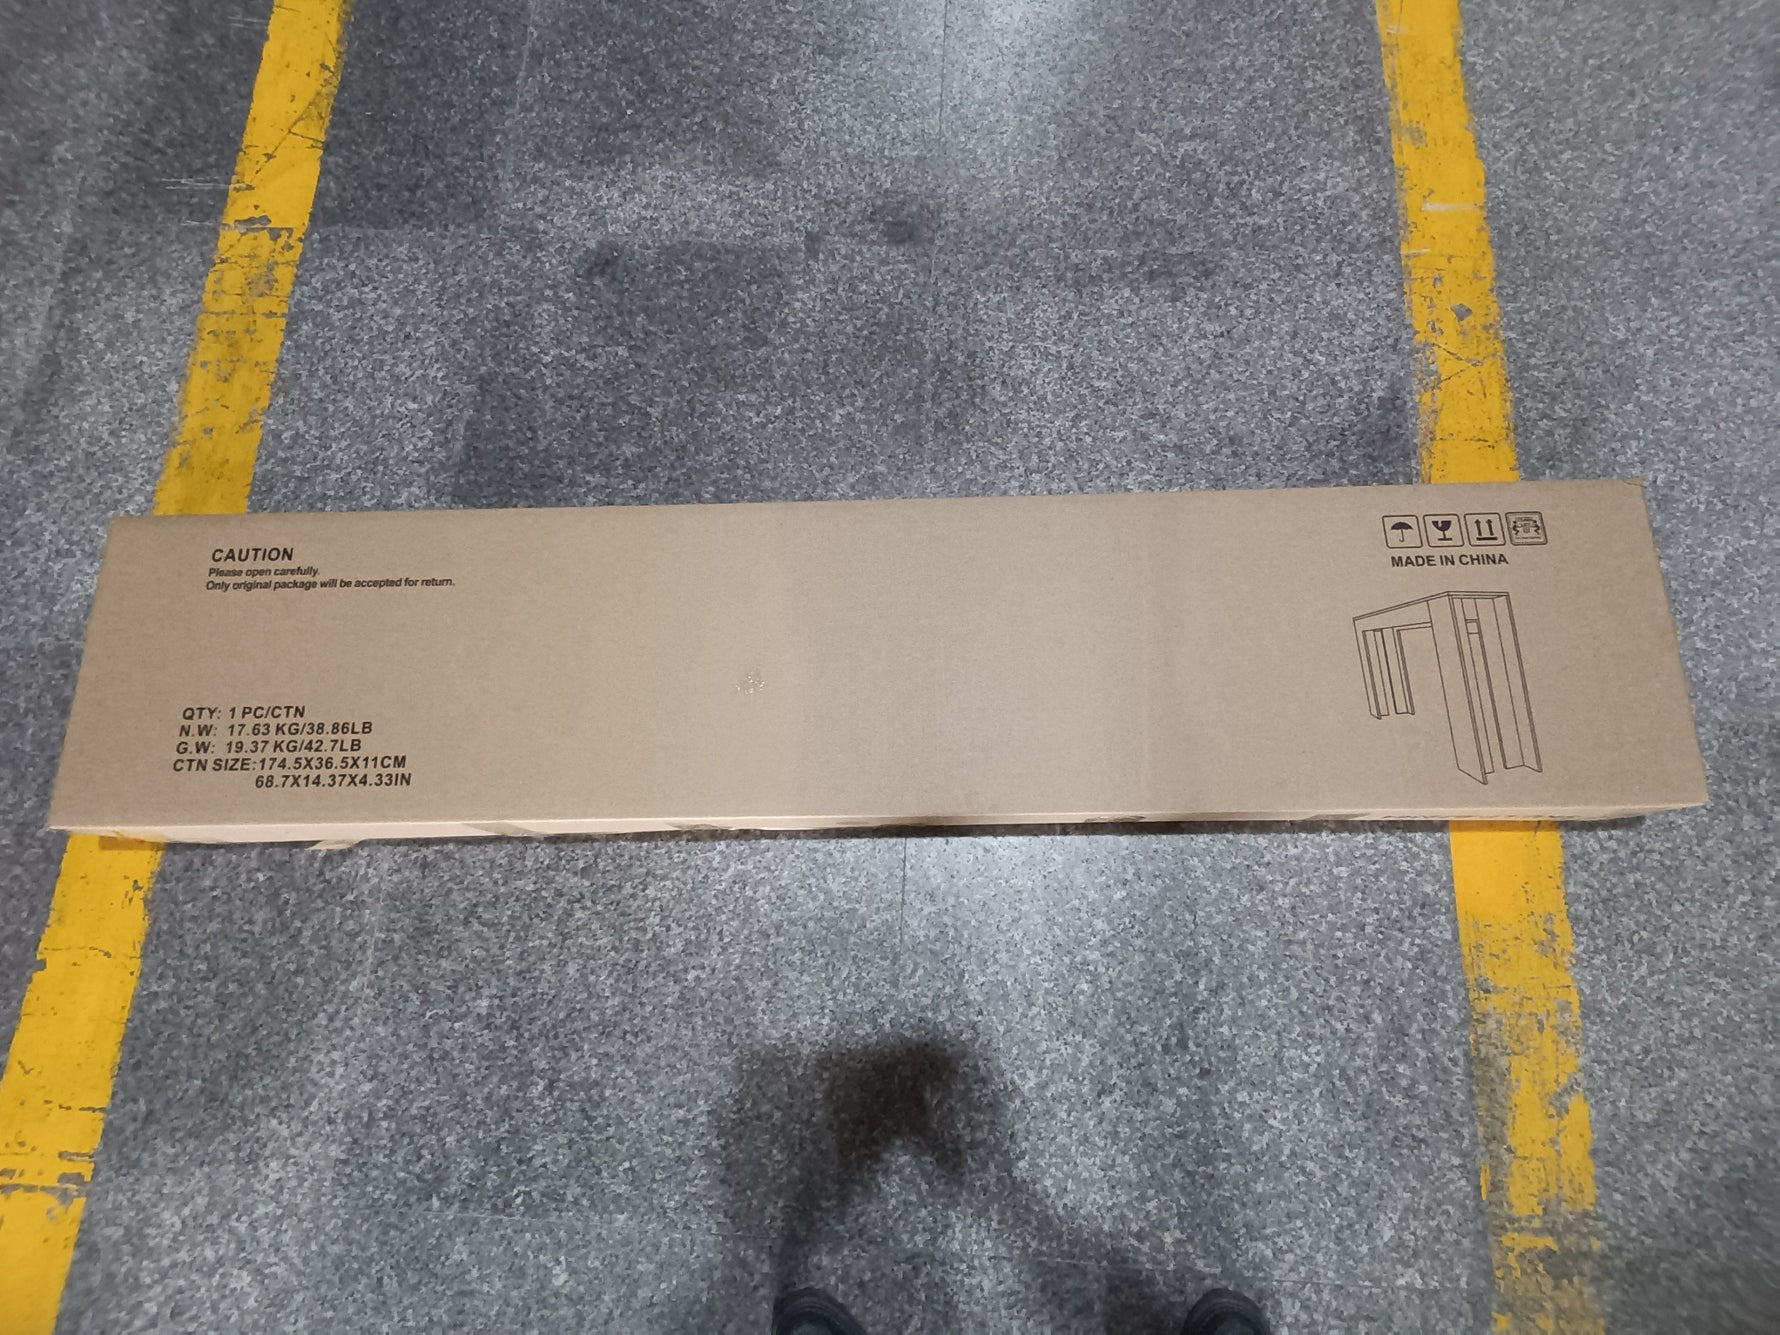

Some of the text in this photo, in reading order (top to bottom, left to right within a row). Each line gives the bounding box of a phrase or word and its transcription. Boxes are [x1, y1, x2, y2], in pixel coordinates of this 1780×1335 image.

[211, 547, 294, 562] CAUTION
[1391, 554, 1508, 567] MADE IN CHINA
[208, 567, 320, 578] Please open carefully.
[206, 578, 455, 592] Only original package will be accepted for return.
[182, 706, 306, 721] QTY: 1 PC/CTN
[179, 722, 373, 737] N.W: 17.63 KG/38.86LB
[176, 739, 362, 755] G.W: 19.37 KG/42.7LB
[173, 759, 208, 772] CTN
[255, 773, 411, 789] 68.7X14.37X4.33IN
